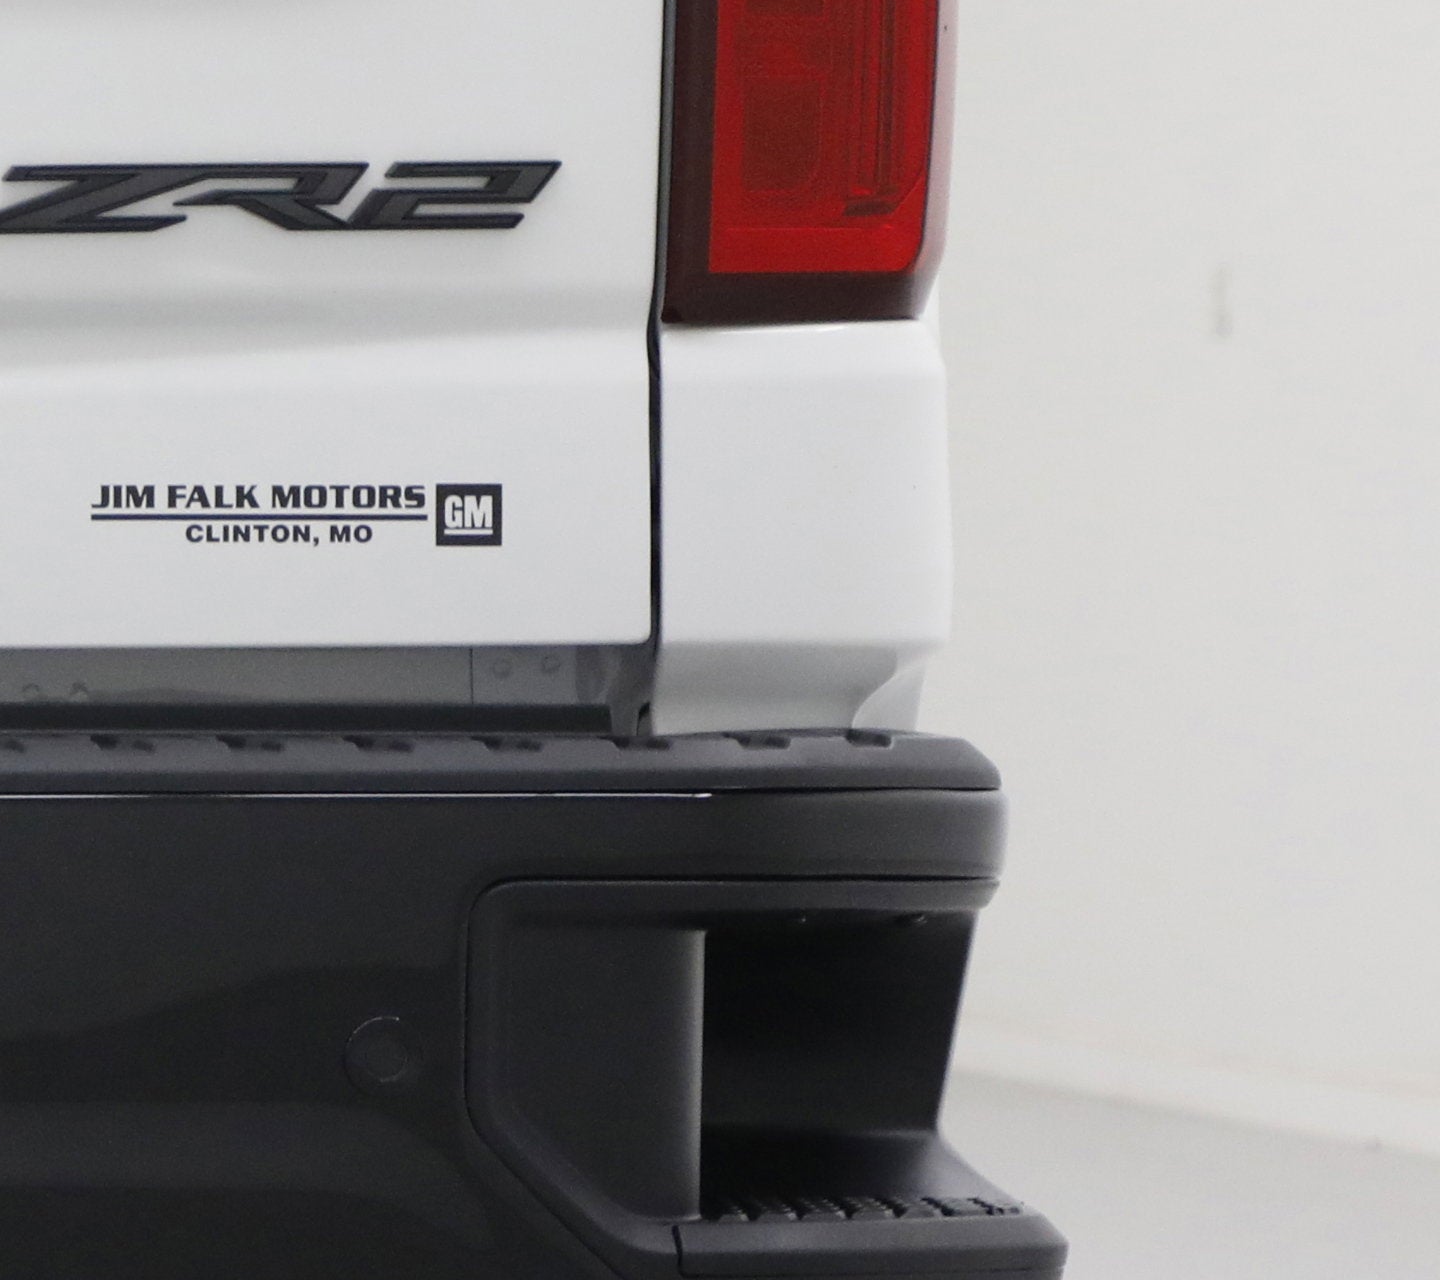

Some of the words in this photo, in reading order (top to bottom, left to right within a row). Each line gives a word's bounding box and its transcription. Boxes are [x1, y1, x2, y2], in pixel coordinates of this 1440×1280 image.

[91, 484, 155, 509] JIM
[167, 484, 260, 509] FALK
[271, 484, 426, 509] MOTORS
[443, 494, 494, 532] GM
[185, 524, 320, 546] CLINTON,
[329, 524, 373, 543] MO
